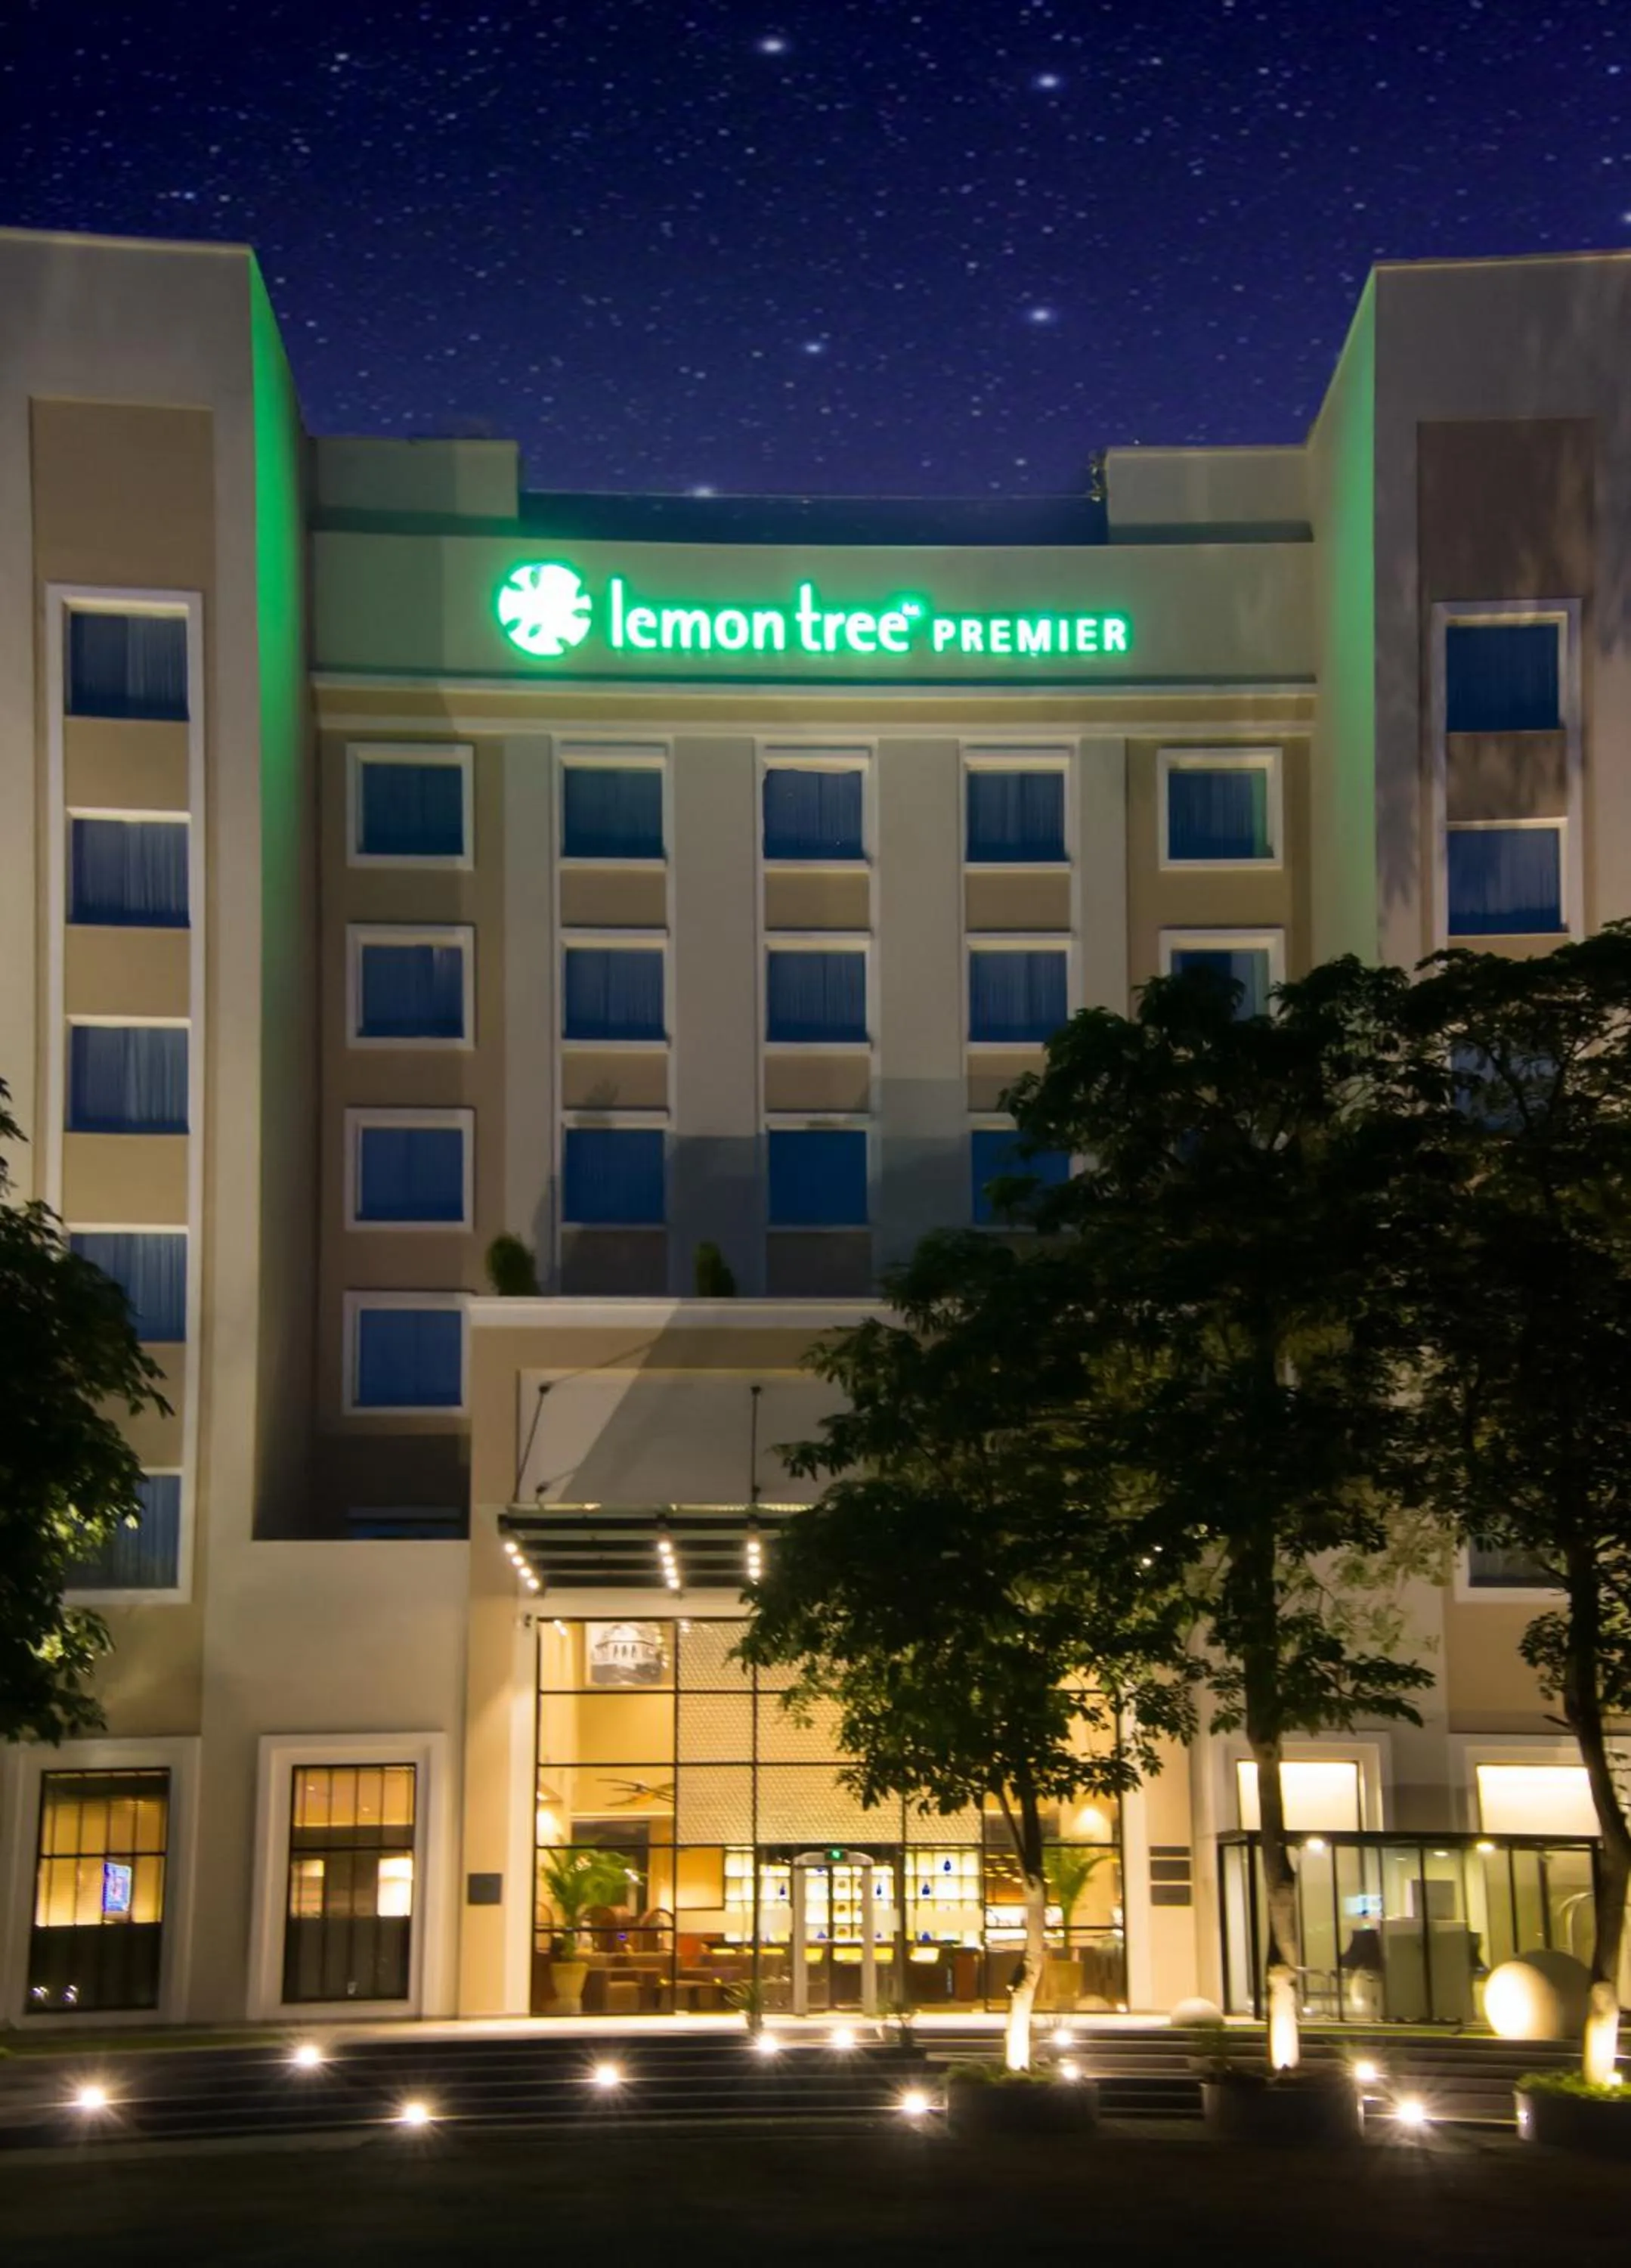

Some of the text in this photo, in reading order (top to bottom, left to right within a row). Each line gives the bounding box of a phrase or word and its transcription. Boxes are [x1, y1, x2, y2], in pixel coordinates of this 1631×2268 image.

[611, 578, 1126, 652] lemon tree PREMIER
